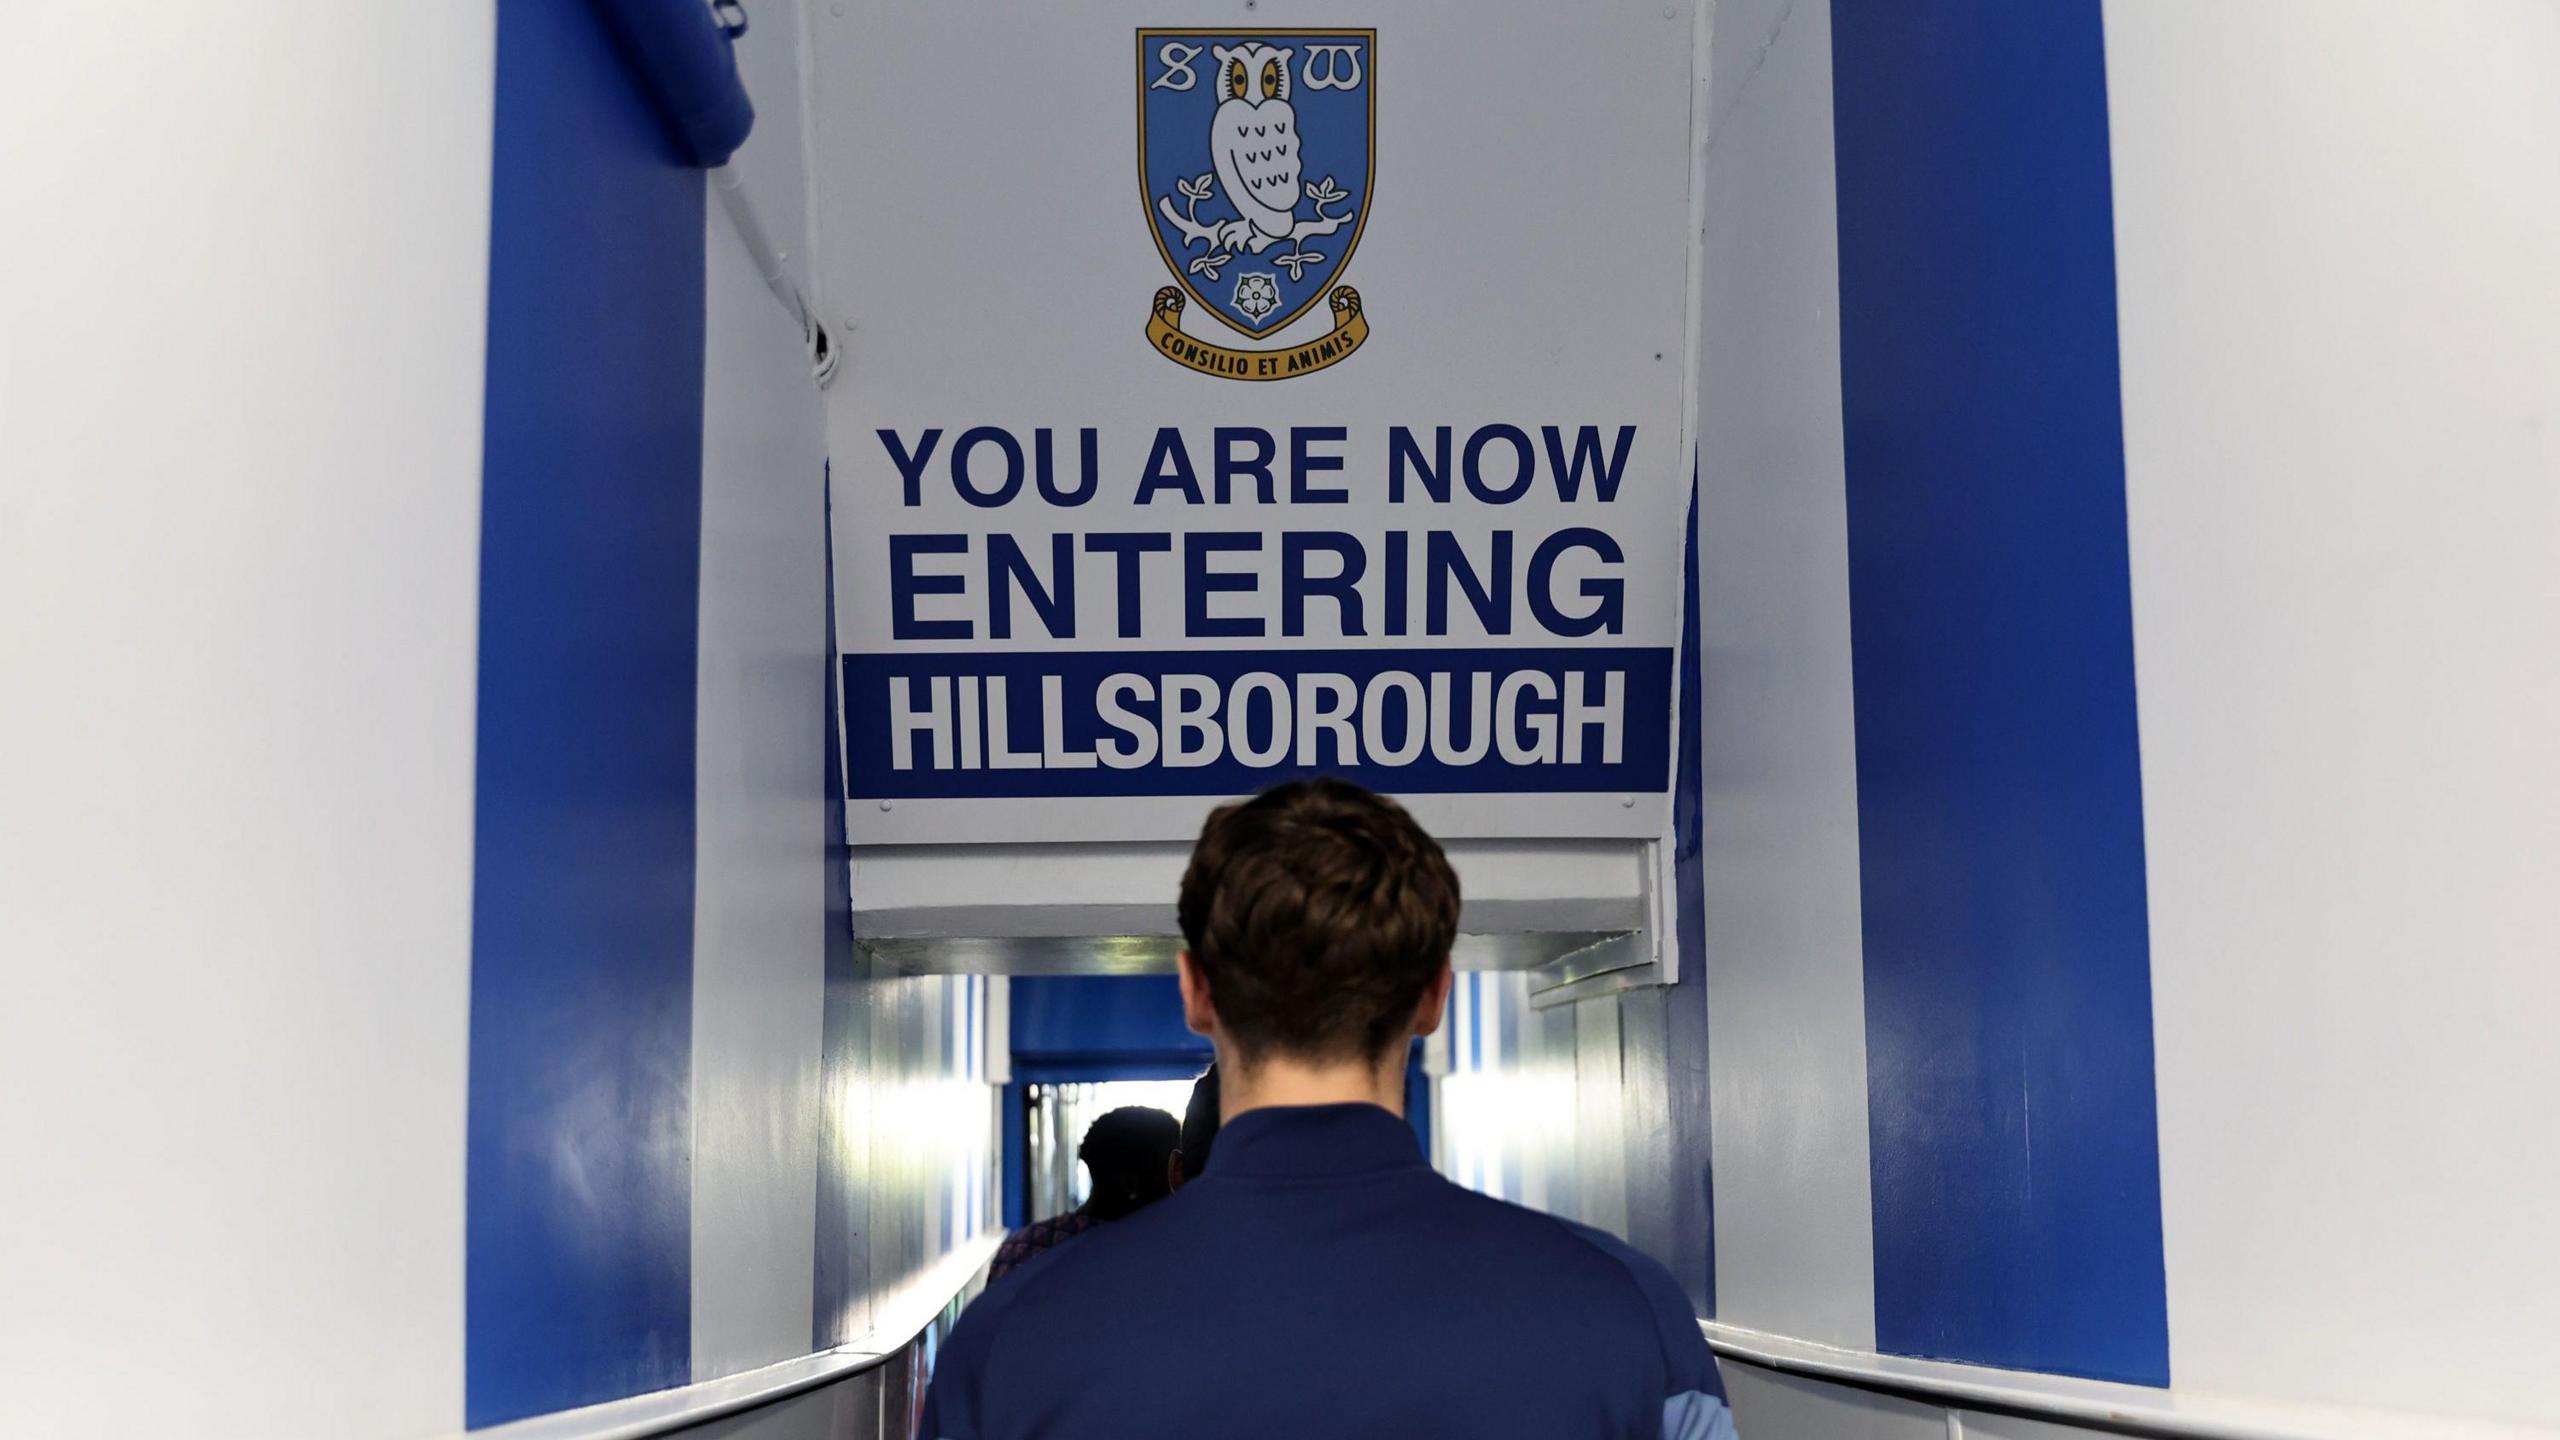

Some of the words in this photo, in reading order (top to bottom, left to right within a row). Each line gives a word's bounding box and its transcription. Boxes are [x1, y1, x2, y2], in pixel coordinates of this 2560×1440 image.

[1151, 42, 1203, 91] S
[1302, 45, 1362, 91] W
[1160, 332, 1248, 375] CONSILIO
[1258, 358, 1278, 376] ET
[1287, 331, 1354, 373] ANIMIS
[876, 427, 1099, 507] YOU
[1133, 426, 1349, 505] ARE
[1388, 424, 1637, 504] NOW
[888, 527, 1625, 640] ENTERING
[889, 670, 1626, 770] HILLSBOROUGH
